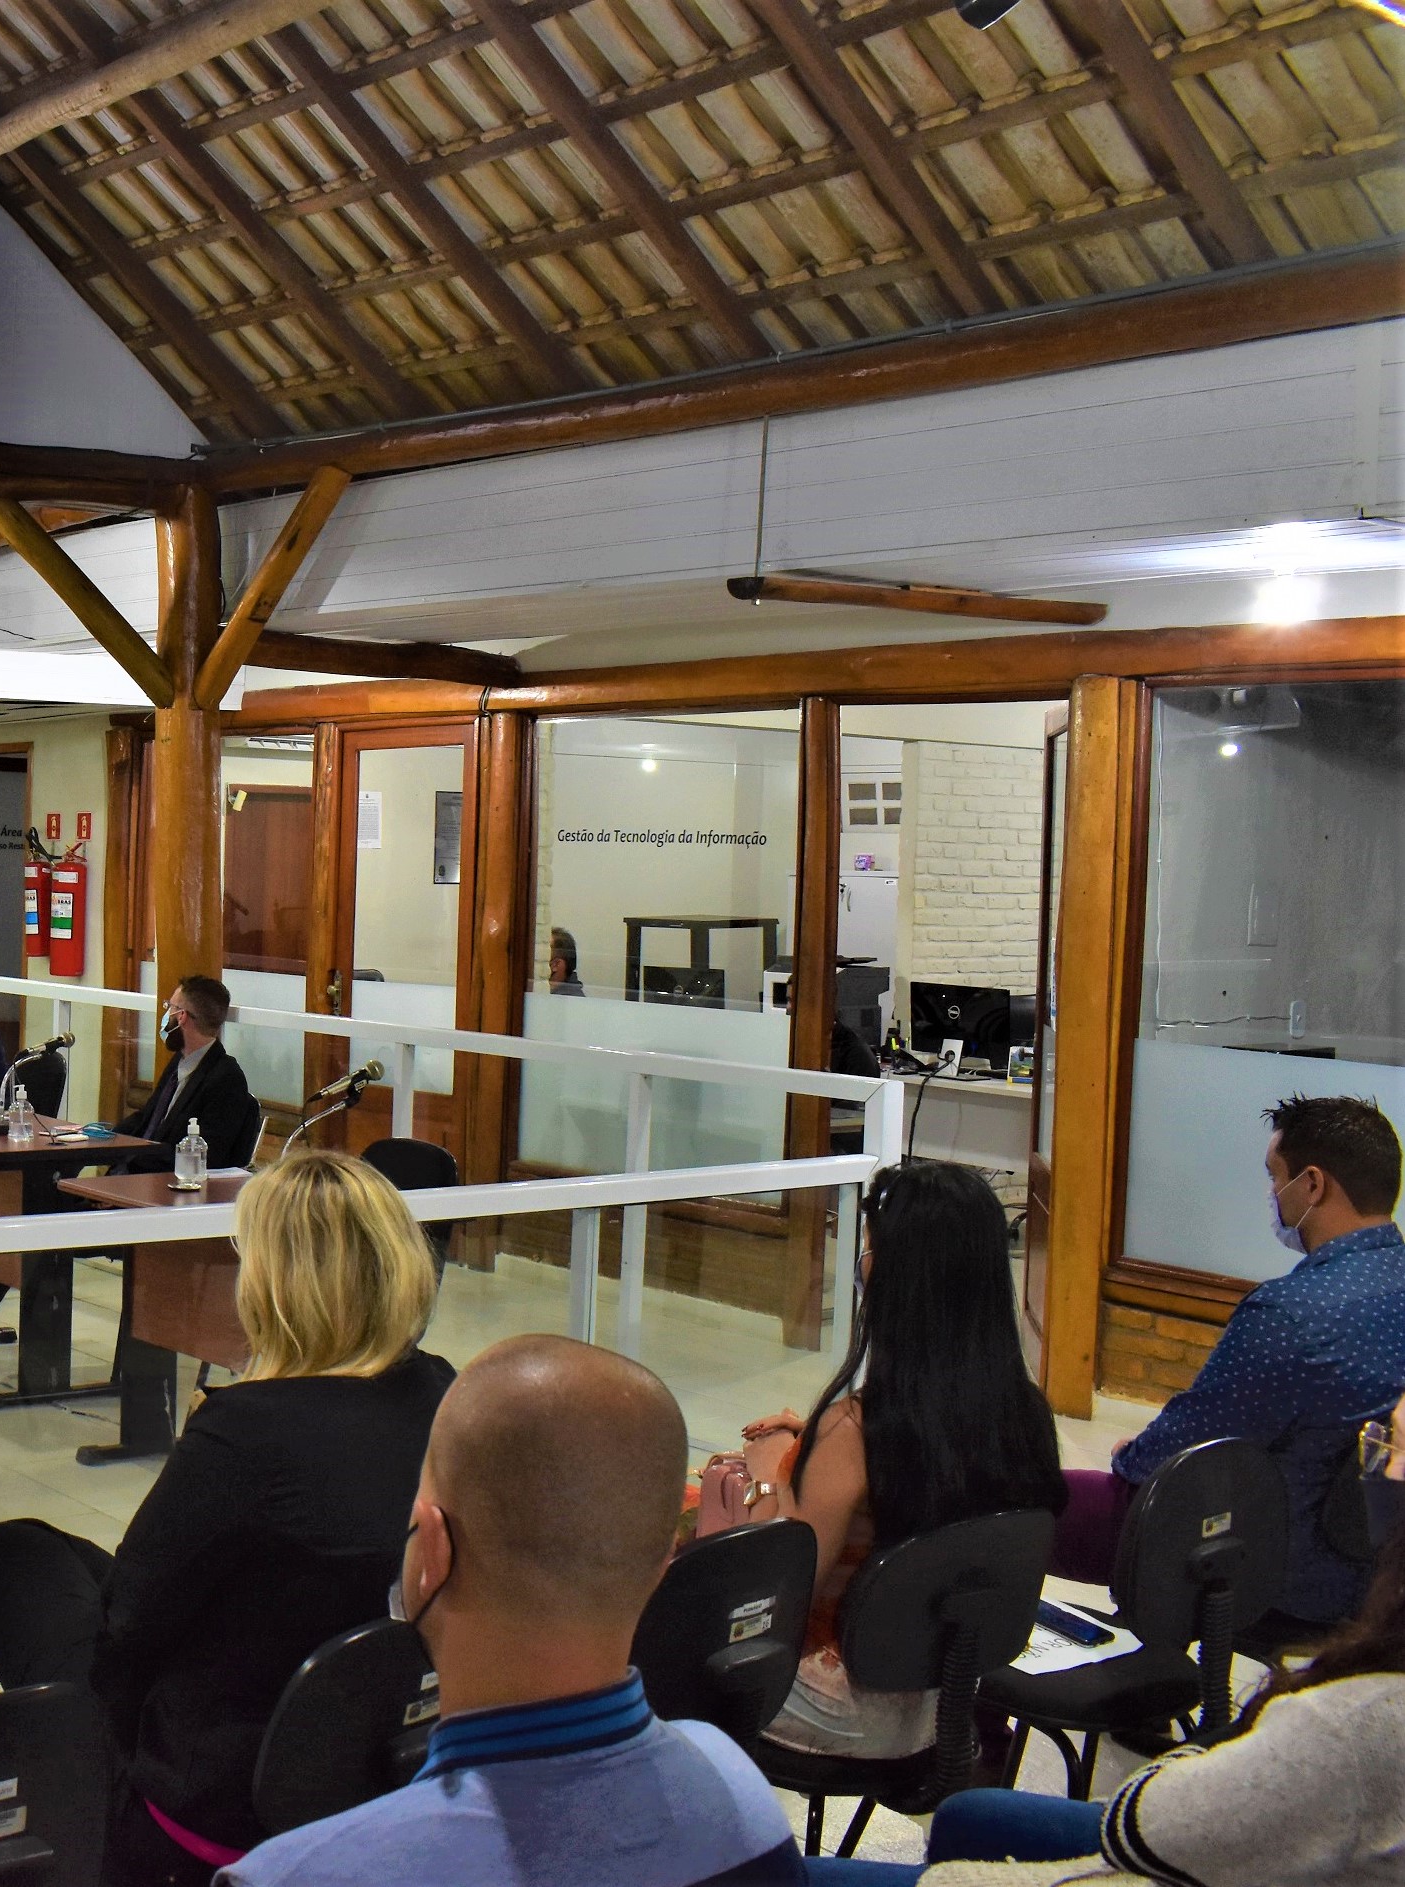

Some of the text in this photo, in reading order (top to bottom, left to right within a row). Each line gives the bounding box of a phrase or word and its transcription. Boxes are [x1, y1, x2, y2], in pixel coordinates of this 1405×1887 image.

[557, 829, 767, 849] Gestão da Tecnologia da Informação
